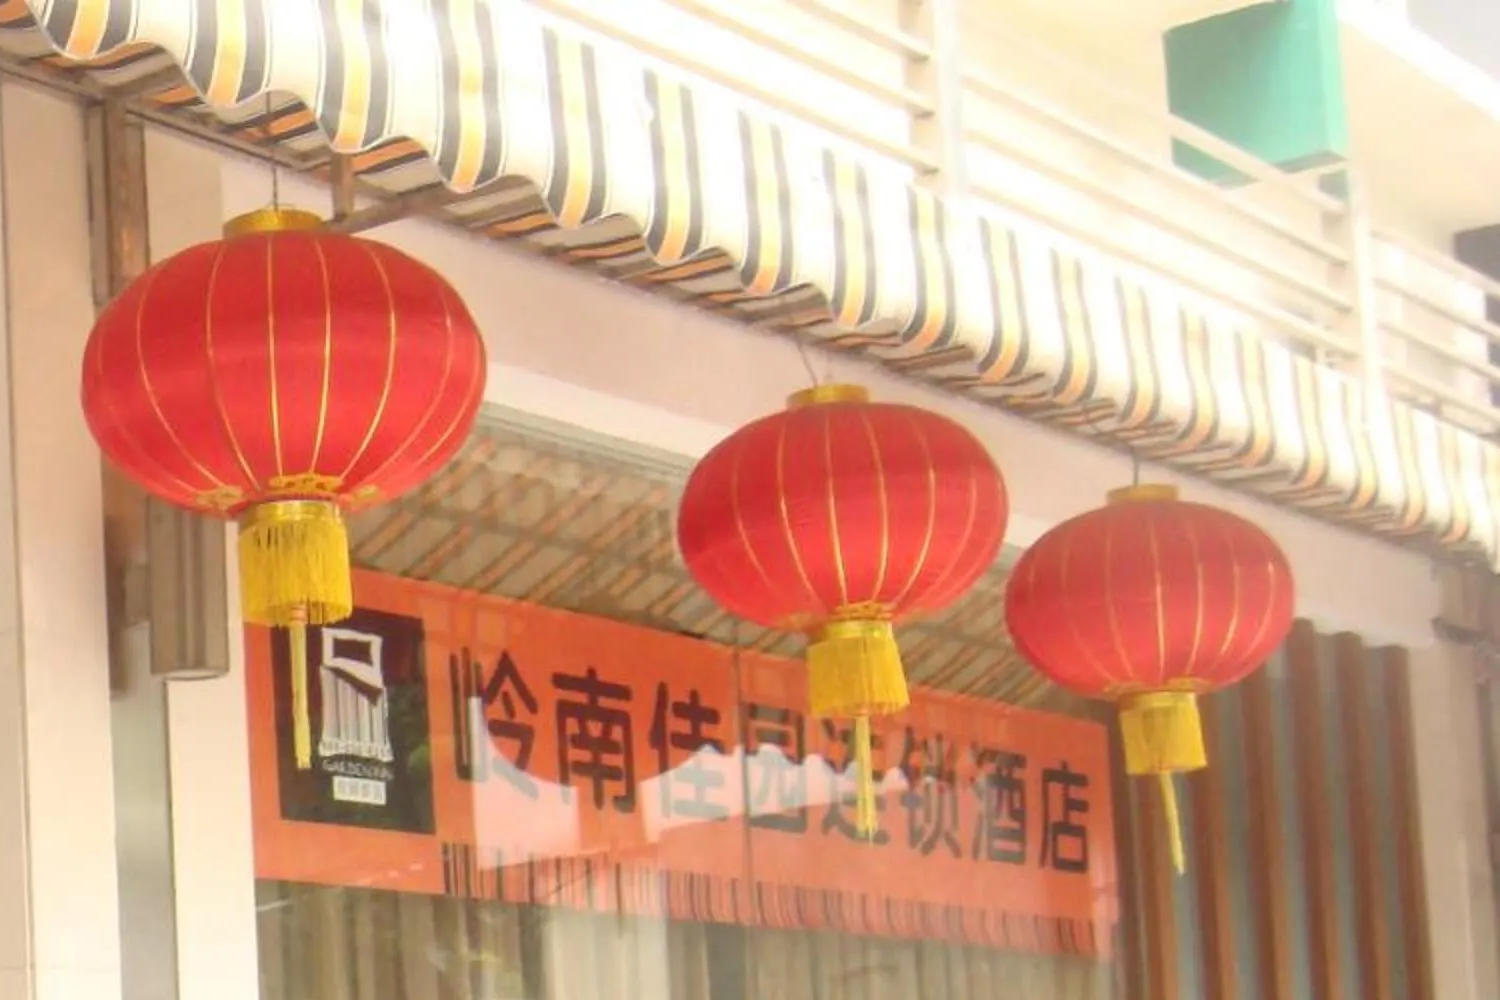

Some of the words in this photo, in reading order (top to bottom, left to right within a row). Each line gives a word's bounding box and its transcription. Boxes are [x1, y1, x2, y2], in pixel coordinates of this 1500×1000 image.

[450, 646, 1091, 873] 岭南佳园连锁酒店
